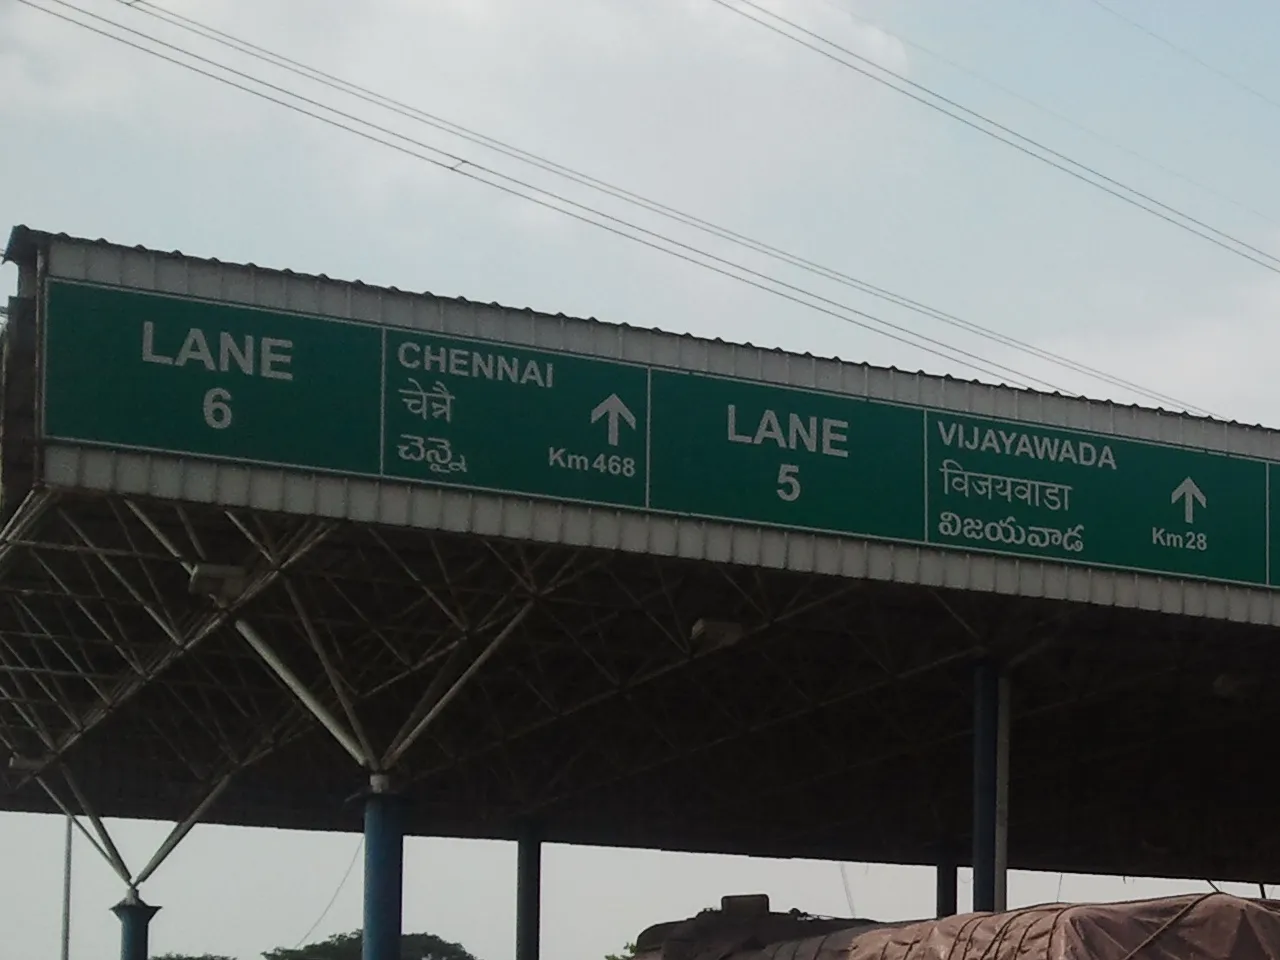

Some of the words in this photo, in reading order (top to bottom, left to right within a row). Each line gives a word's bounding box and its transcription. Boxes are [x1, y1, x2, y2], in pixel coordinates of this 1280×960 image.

[141, 321, 294, 381] LANE
[397, 342, 554, 387] CHENNAI
[202, 388, 233, 429] 6
[727, 404, 849, 458] LANE
[937, 421, 1117, 470] VIJAYAWADA
[777, 464, 801, 502] 5
[938, 458, 1073, 512] विजयवाडा
[938, 511, 1085, 553] విజయవాడ
